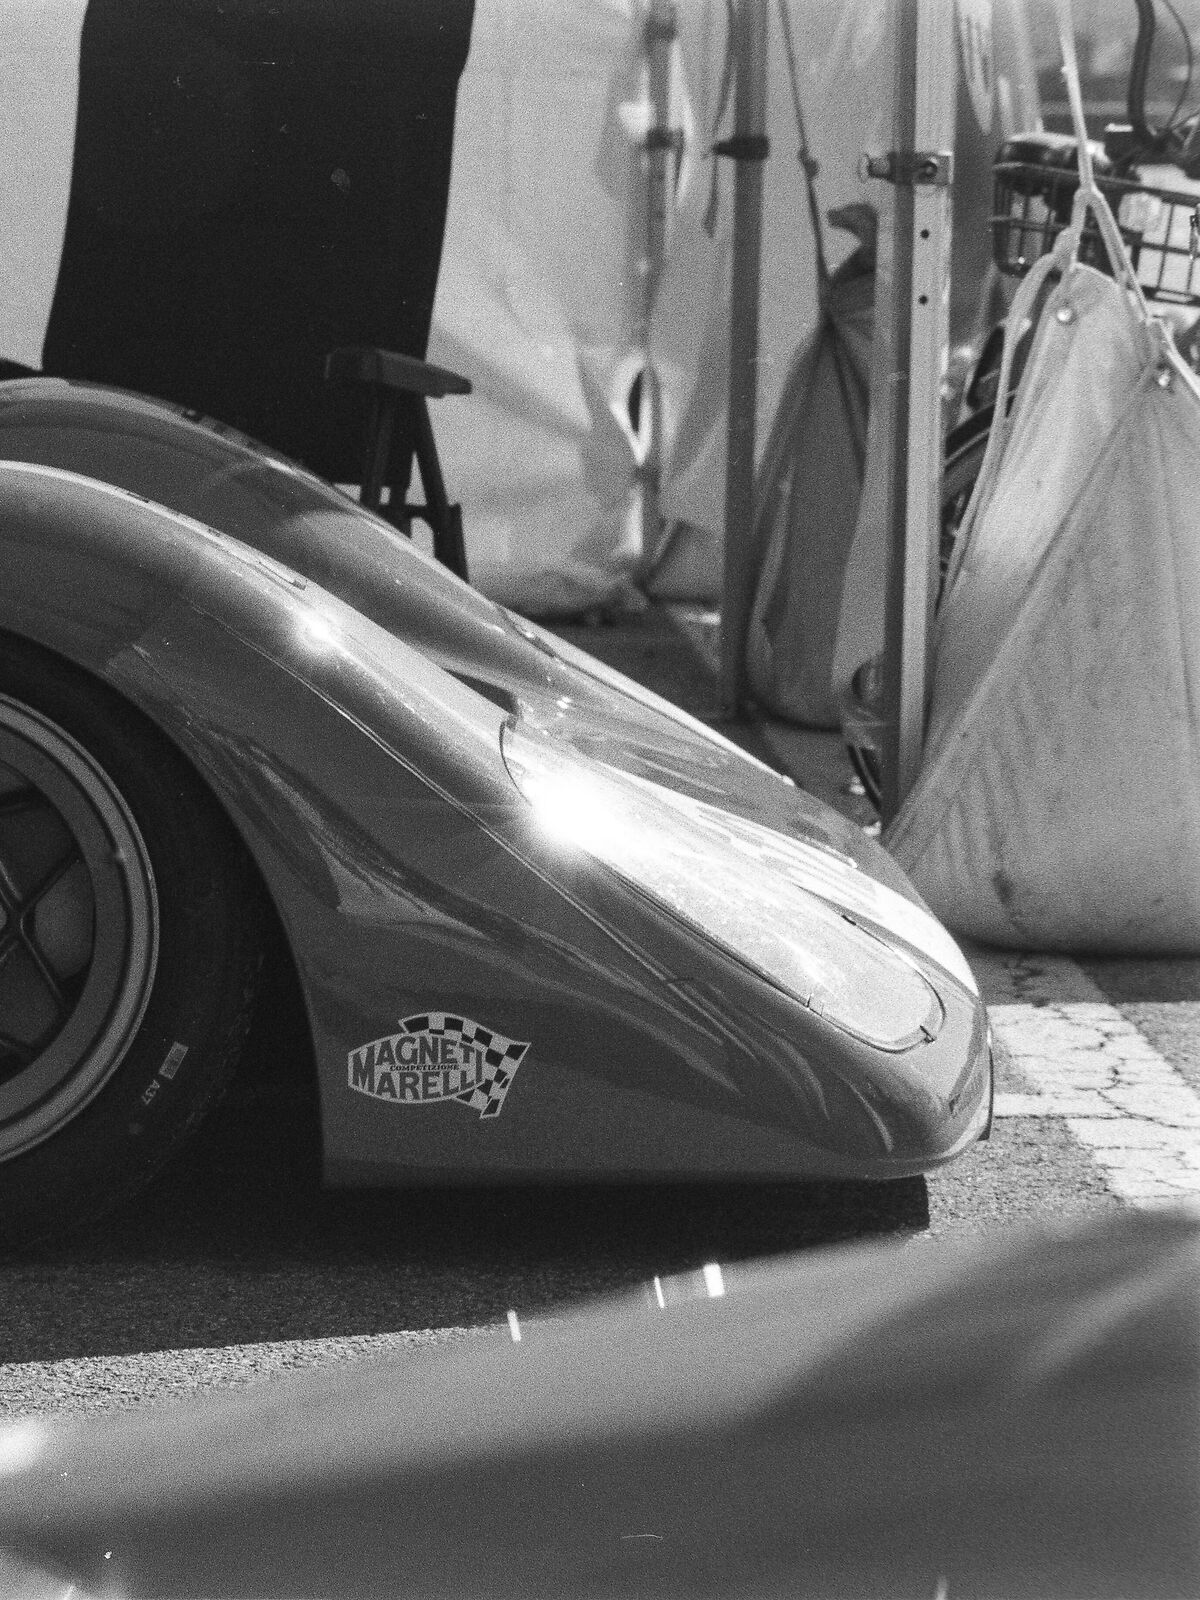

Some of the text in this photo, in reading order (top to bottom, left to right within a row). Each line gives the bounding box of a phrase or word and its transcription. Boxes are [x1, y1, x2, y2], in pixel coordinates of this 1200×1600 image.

[352, 1035, 483, 1090] MAGNETI
[352, 1050, 483, 1100] MARELLI
[390, 1064, 460, 1072] COMPETIZIONE
